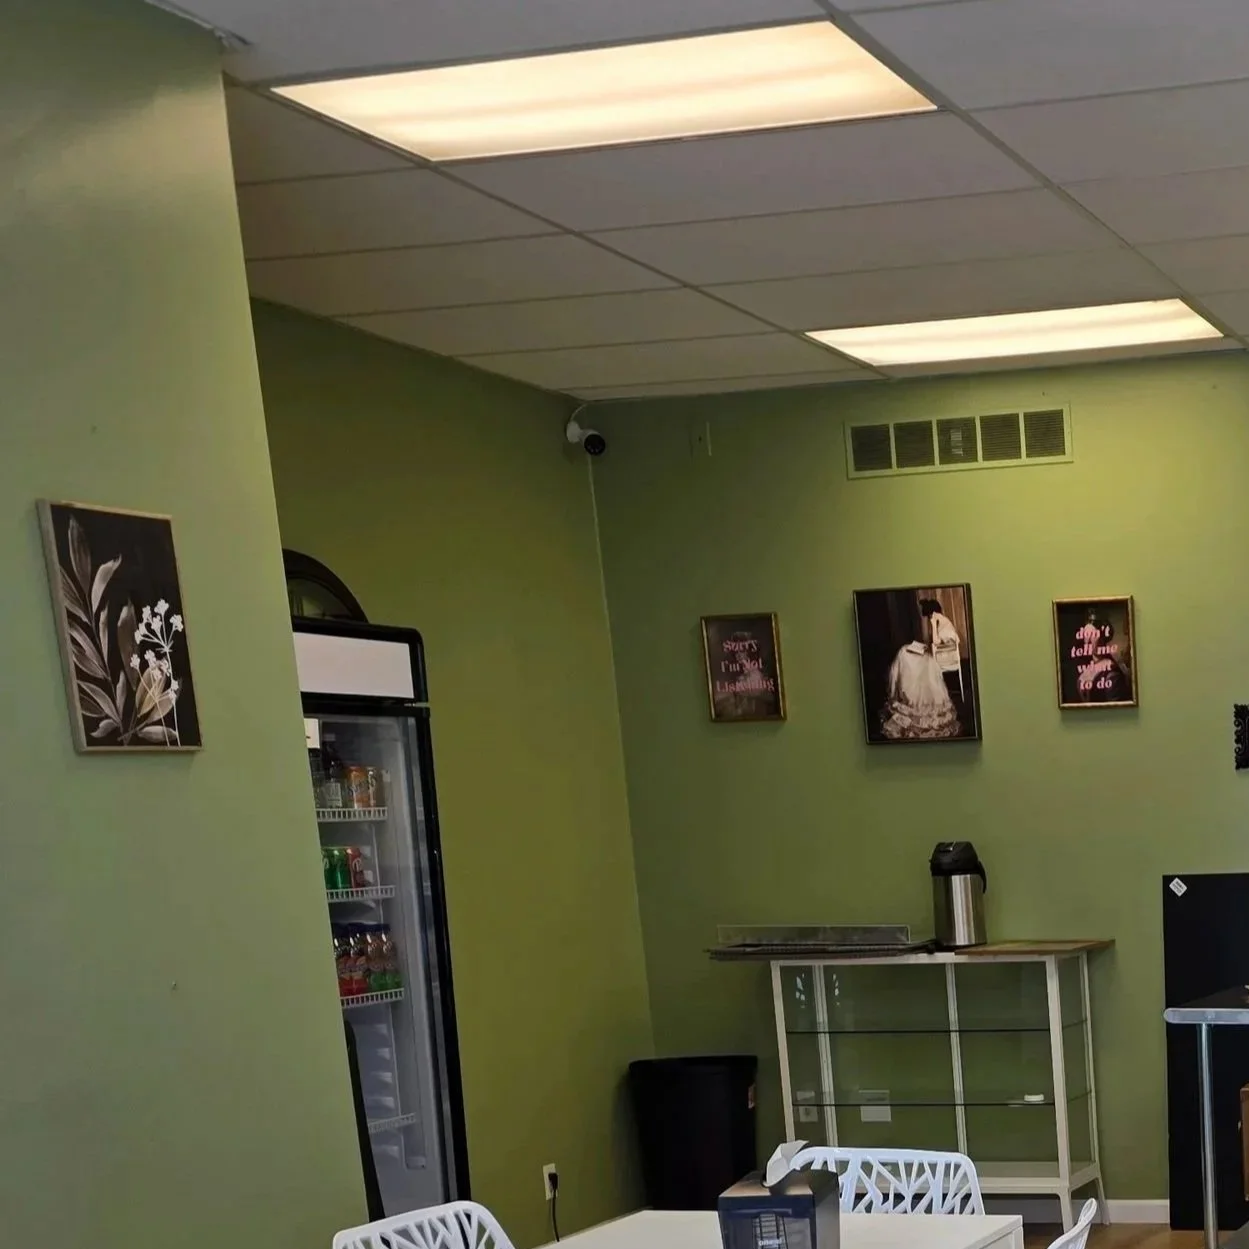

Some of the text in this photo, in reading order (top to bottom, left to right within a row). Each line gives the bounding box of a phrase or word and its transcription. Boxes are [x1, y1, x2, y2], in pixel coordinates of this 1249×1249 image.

[1076, 625, 1110, 640] don't
[1071, 643, 1118, 658] tell me
[1077, 660, 1112, 673] what
[1080, 677, 1113, 690] to do
